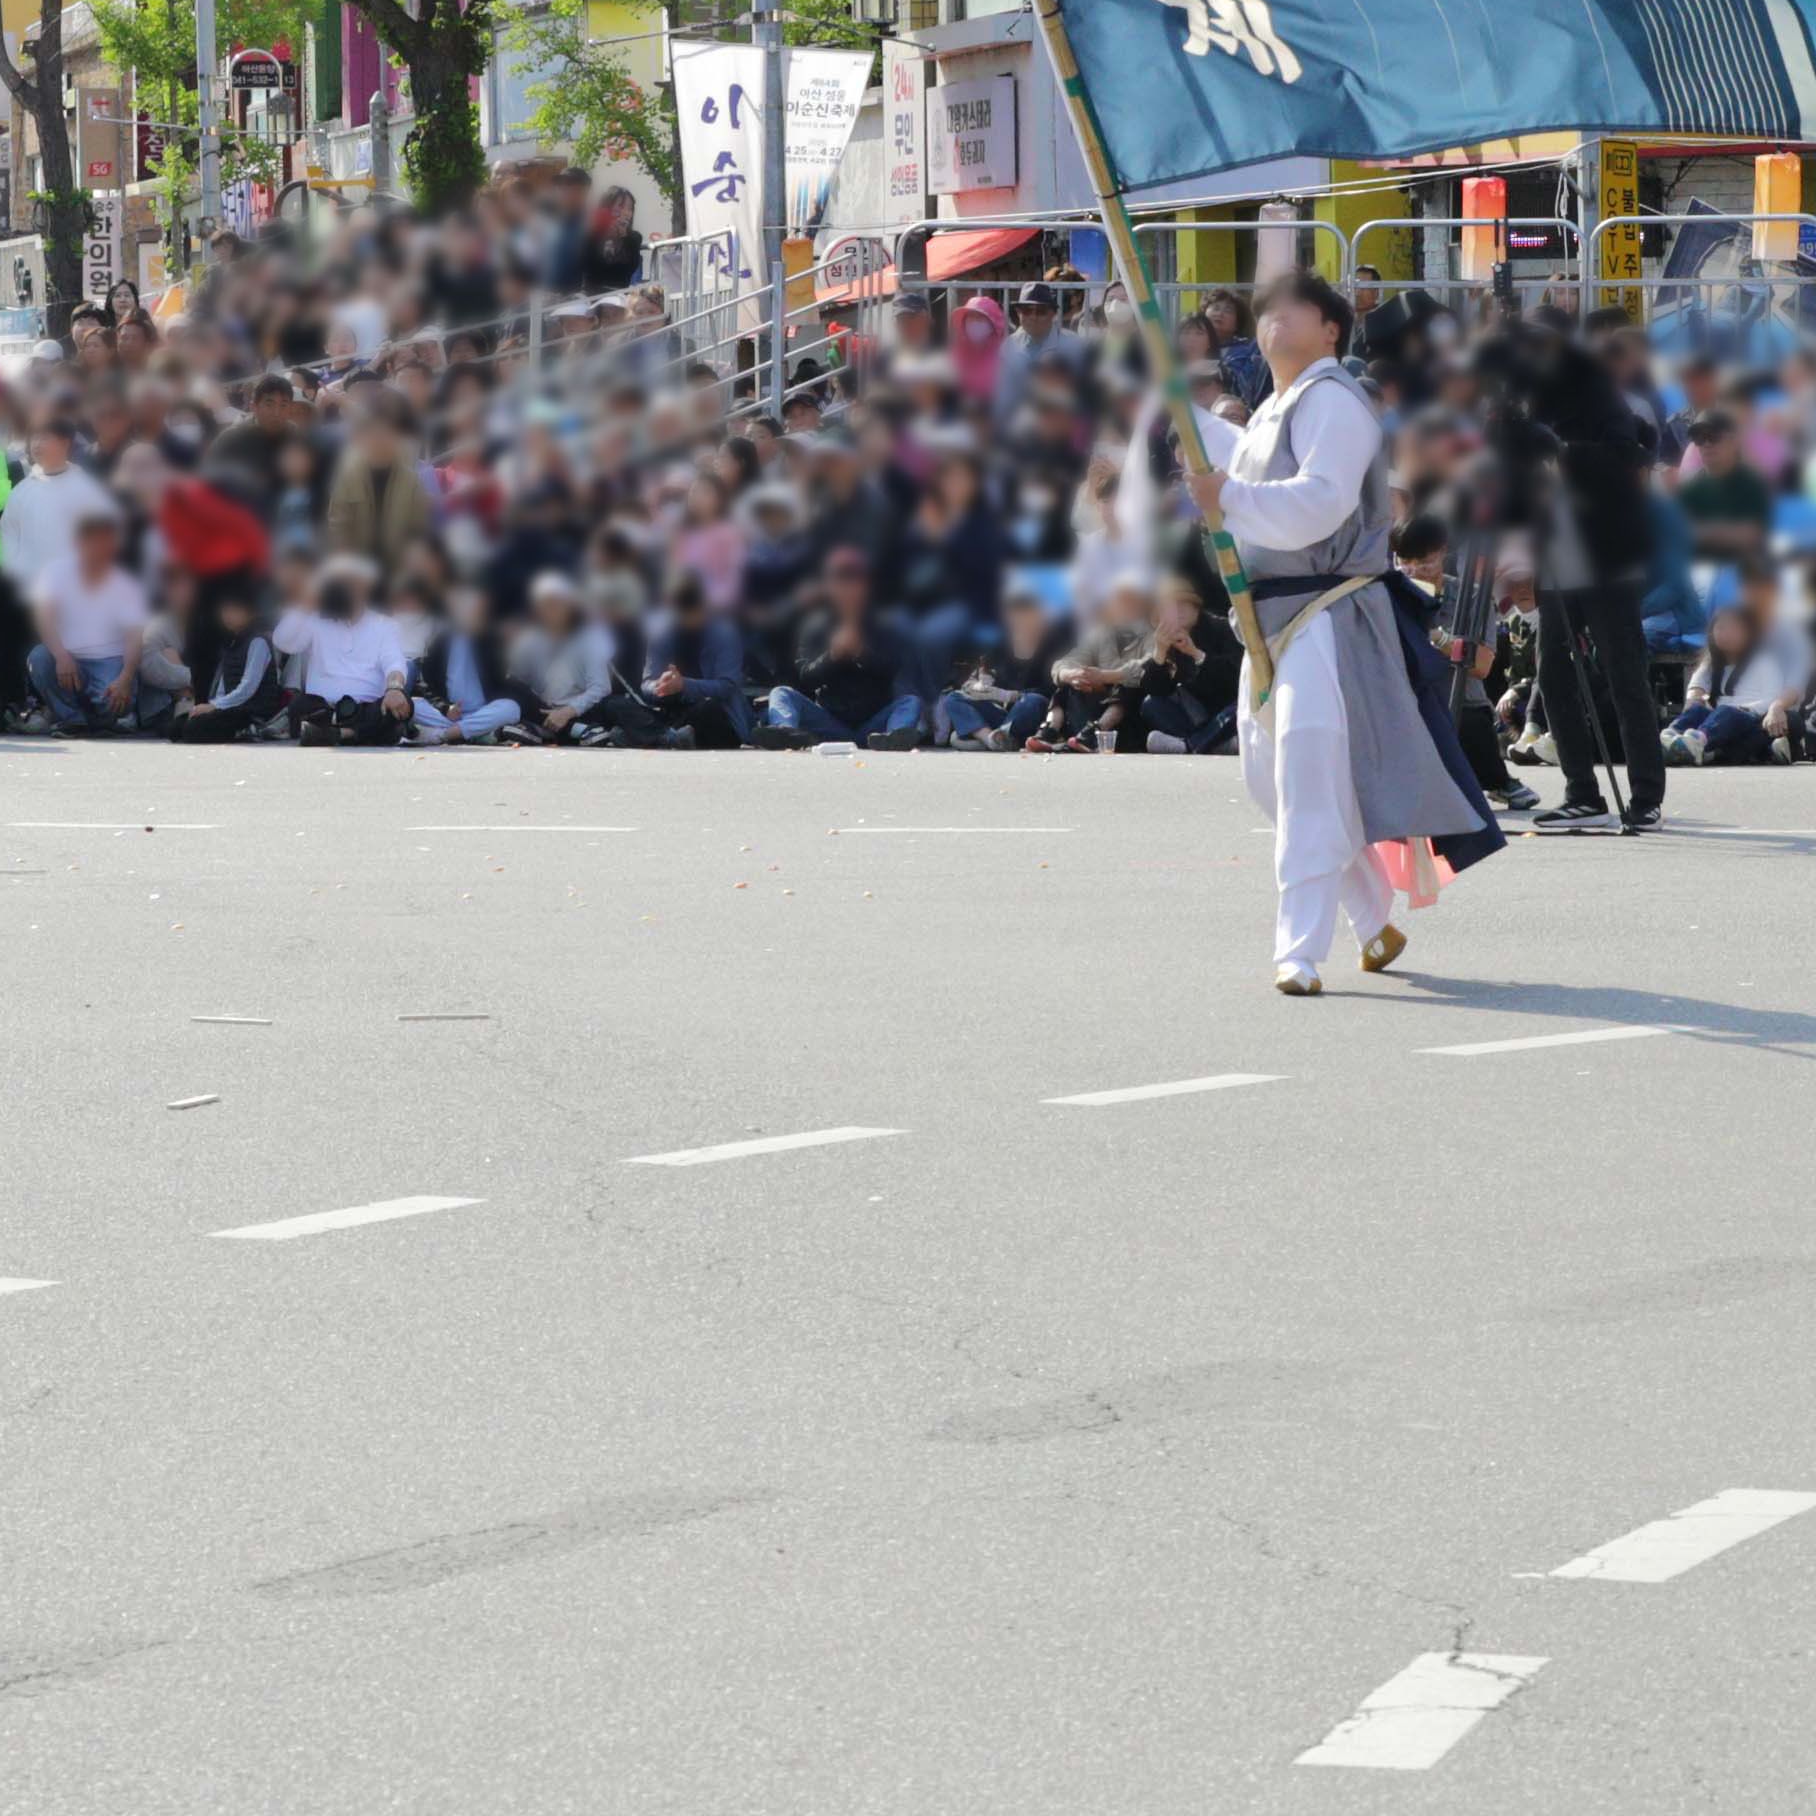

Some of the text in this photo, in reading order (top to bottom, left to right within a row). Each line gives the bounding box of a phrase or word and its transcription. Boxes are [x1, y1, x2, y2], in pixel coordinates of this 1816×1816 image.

[894, 110, 915, 157] 무인
[691, 83, 753, 279] 이순신
[88, 215, 113, 296] 한의원
